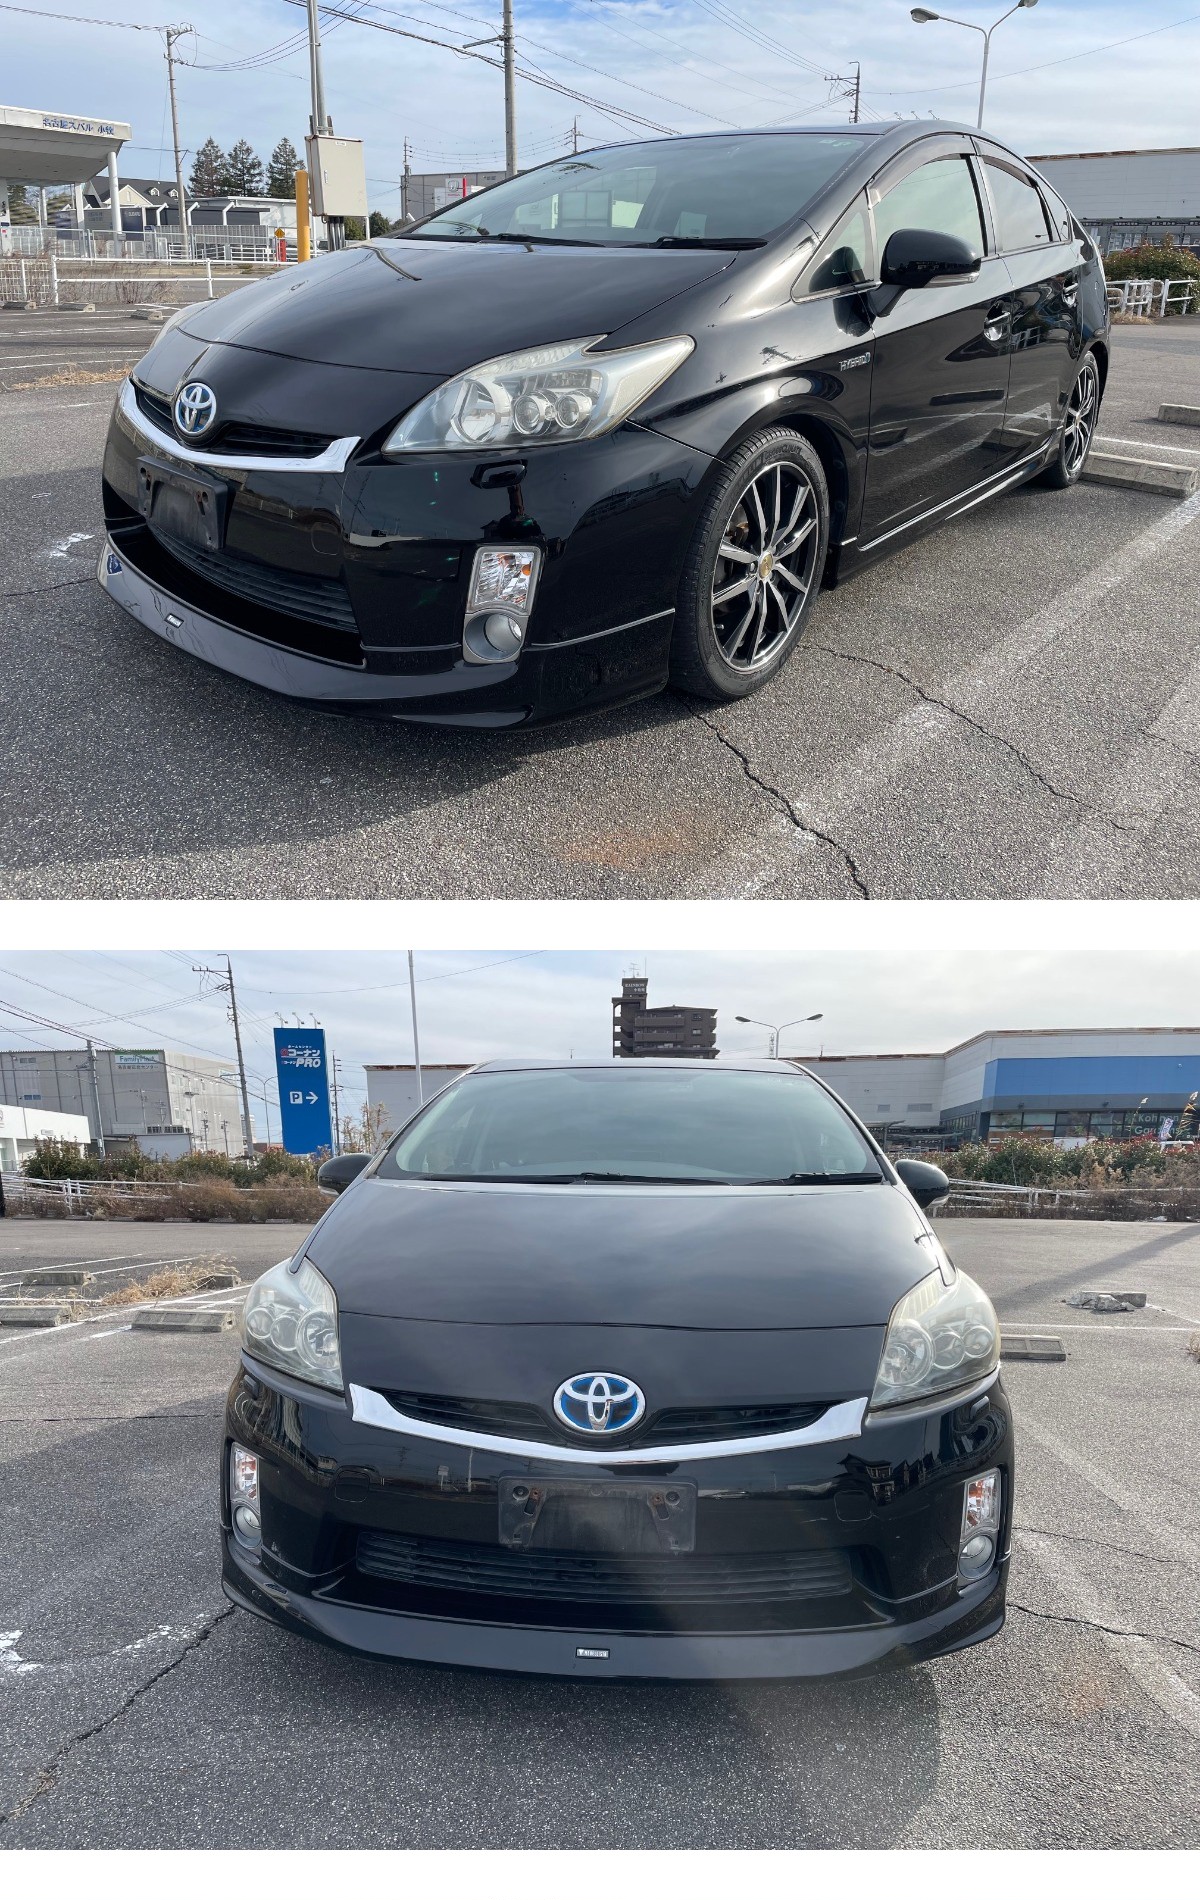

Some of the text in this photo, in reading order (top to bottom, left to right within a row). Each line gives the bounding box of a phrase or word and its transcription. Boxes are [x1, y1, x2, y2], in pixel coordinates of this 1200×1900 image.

[288, 1048, 320, 1057] コーナン
[295, 1057, 321, 1068] PRO
